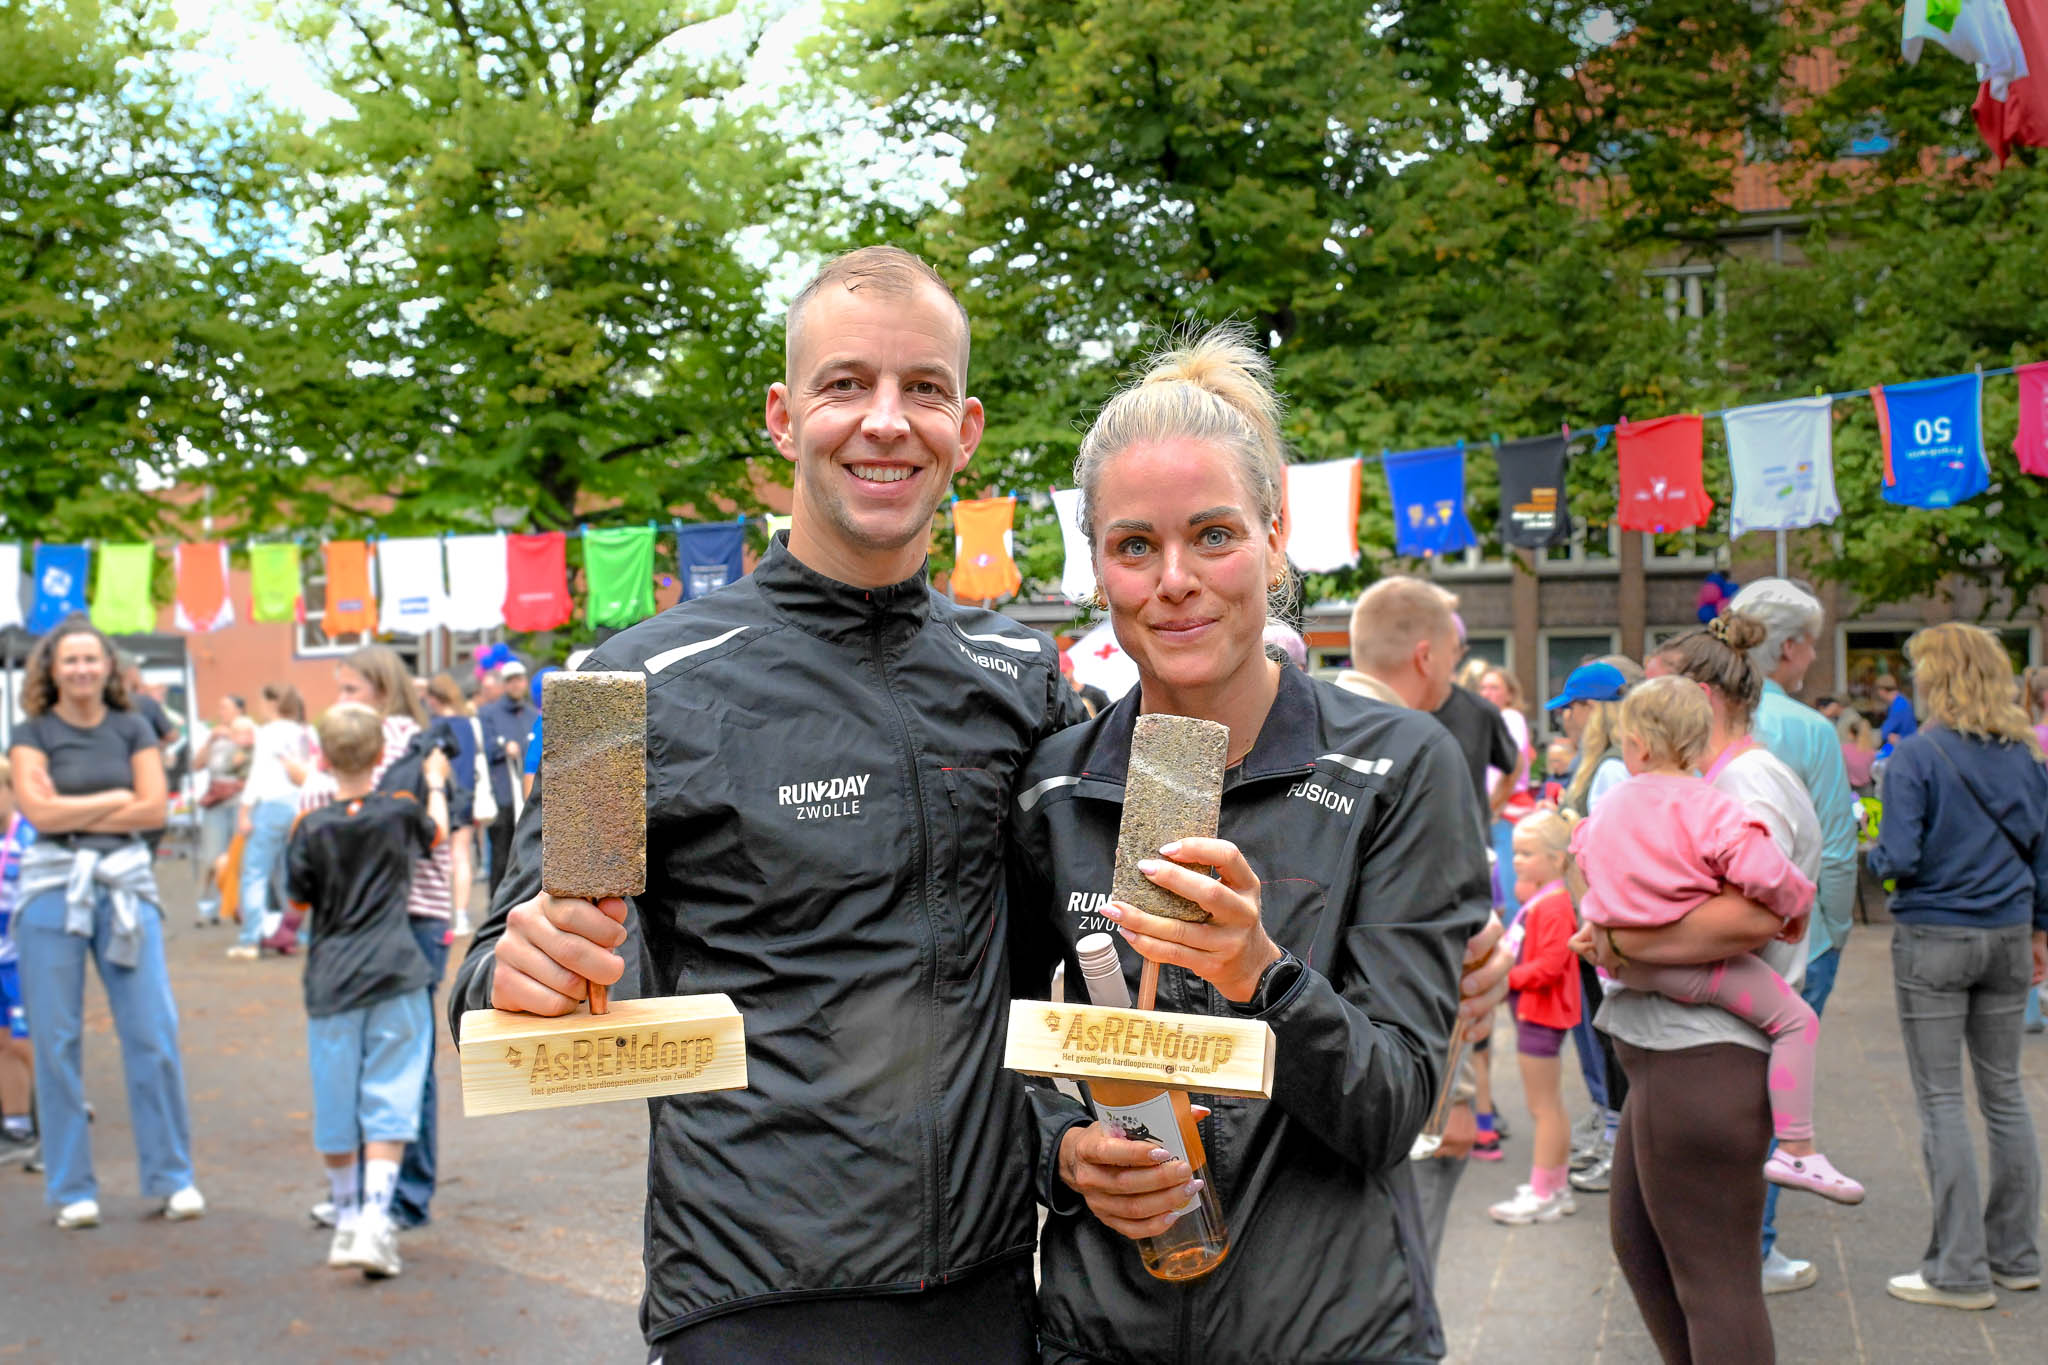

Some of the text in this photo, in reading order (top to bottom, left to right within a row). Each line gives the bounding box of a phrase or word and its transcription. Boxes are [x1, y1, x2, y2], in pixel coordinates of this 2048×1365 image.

[1915, 418, 1951, 444] 50
[779, 774, 870, 805] RUN2DAY
[1287, 782, 1354, 815] FUSION
[797, 800, 860, 820] ZWOLLE
[529, 1032, 713, 1083] AsRENdorp
[1063, 1014, 1233, 1073] AsRENdorp
[1062, 1052, 1074, 1061] Het
[1075, 1055, 1112, 1066] gezelligste
[1179, 1064, 1190, 1073] van
[1191, 1064, 1211, 1074] Zwolle
[531, 1071, 695, 1096] Het gezelligste hardloopevenement van Zwolle
